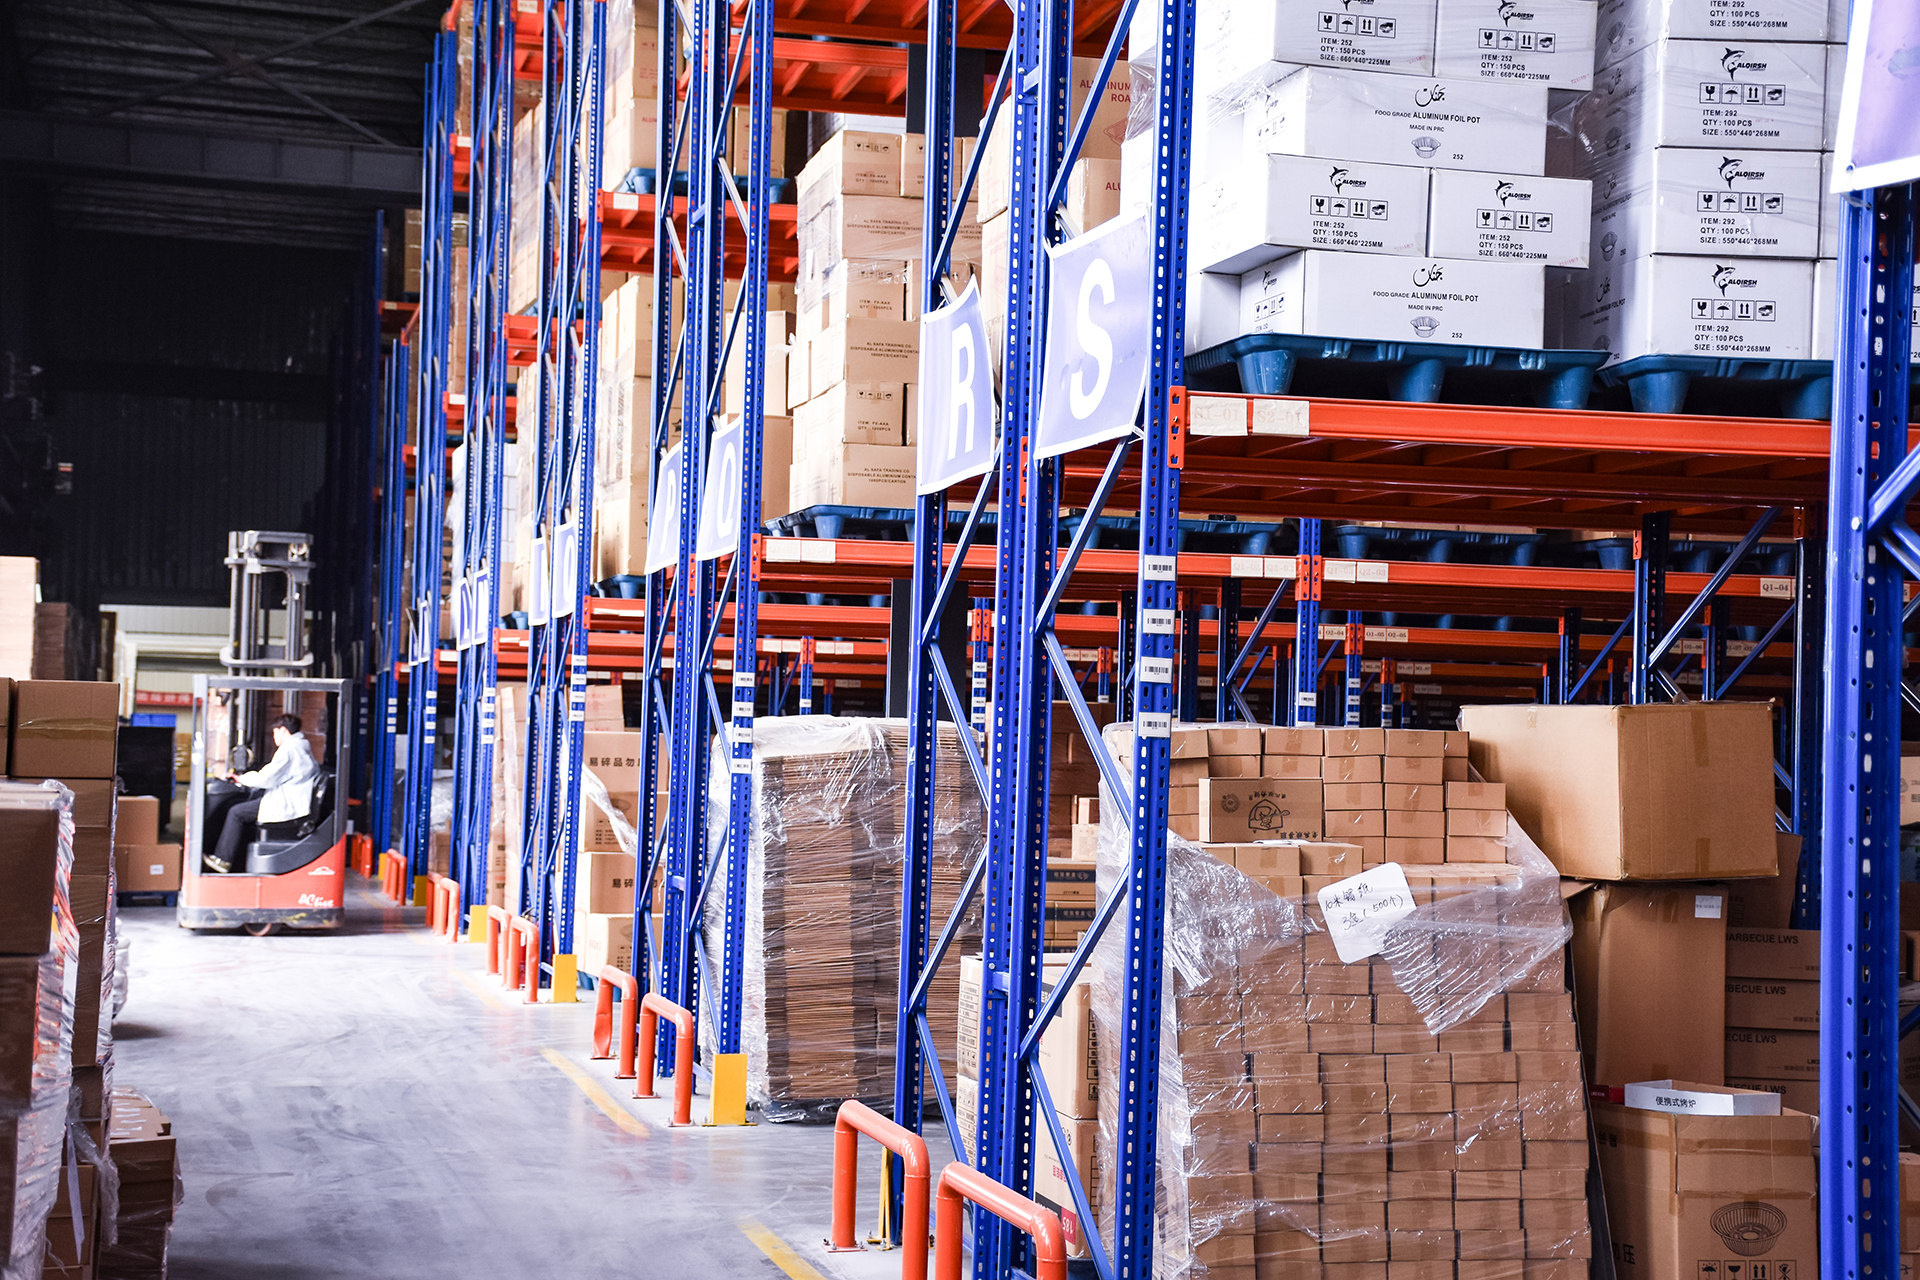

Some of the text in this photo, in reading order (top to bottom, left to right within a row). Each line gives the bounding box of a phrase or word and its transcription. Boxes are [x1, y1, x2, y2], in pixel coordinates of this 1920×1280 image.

[1321, 38, 1339, 47] ITEM:
[1340, 45, 1352, 54] 150
[1482, 54, 1499, 63] ITEM:
[1500, 61, 1512, 70] 150
[1413, 112, 1449, 120] ALUMINUM
[1411, 292, 1447, 300] ALUMINUM
[1070, 258, 1115, 420] S
[948, 322, 975, 461] R
[1194, 406, 1238, 421] S1-01
[1256, 410, 1301, 424] S2-01
[717, 442, 736, 539] Q
[661, 468, 676, 554] P
[1359, 568, 1386, 577] Q2-03
[1762, 584, 1789, 592] Q1-04
[589, 757, 640, 767] 易碎品勿
[1725, 933, 1799, 944] ARBECUE LWS
[1765, 986, 1786, 995] LWS
[1755, 1034, 1777, 1044] LWS
[1765, 1085, 1787, 1094] LWS
[1656, 1096, 1696, 1108] 便携式烤炉
